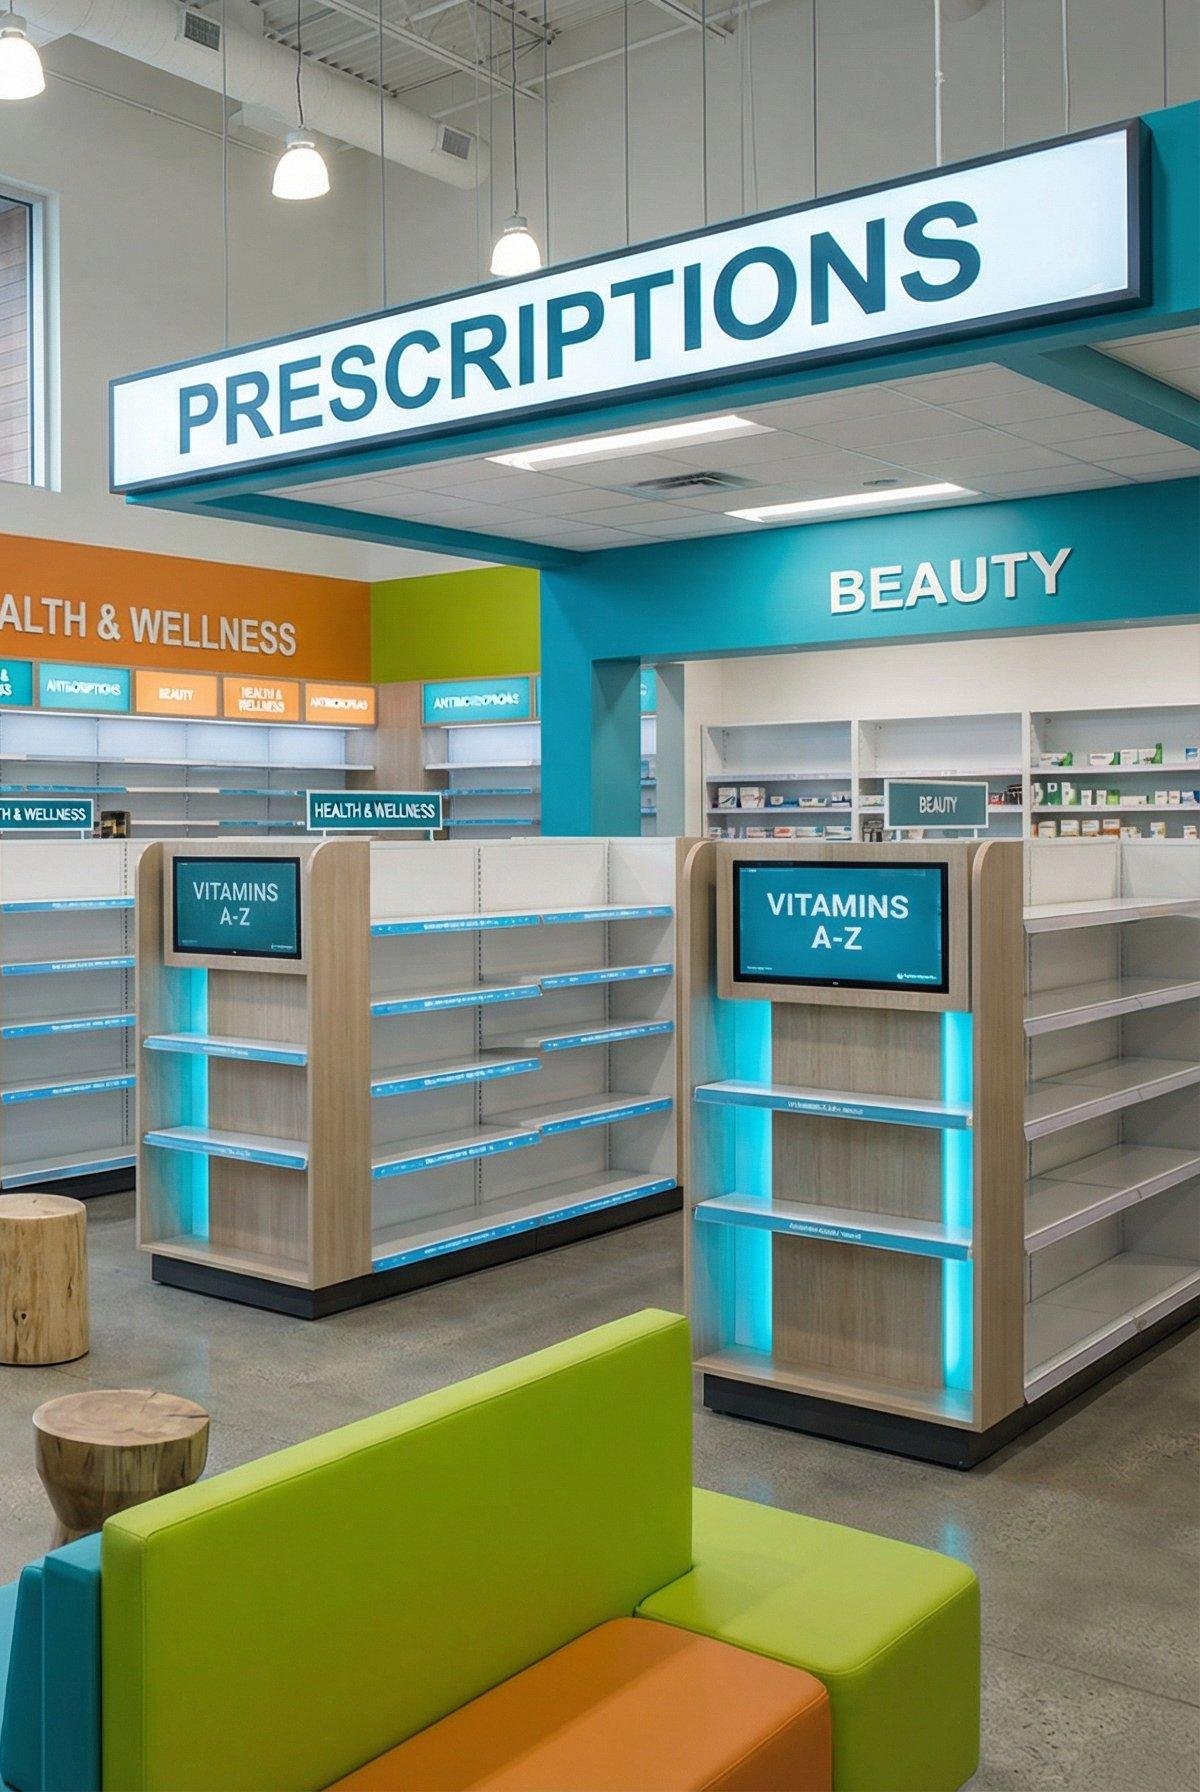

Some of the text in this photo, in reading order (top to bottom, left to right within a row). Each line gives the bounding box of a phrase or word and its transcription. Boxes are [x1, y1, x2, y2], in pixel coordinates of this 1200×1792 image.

[179, 199, 982, 455] PRESCRIPTIONS
[830, 547, 1072, 615] BEAUTY
[97, 603, 121, 641] &
[130, 606, 297, 657] WELLNESS
[0, 668, 9, 682] &
[13, 807, 22, 821] &
[23, 807, 87, 822] WELLNESS
[314, 801, 436, 820] HEALTH & WELLNESS
[919, 796, 958, 814] BEAUTY
[192, 881, 279, 902] VITAMINS
[219, 905, 251, 926] A-Z
[766, 892, 909, 920] VITAMINS
[811, 925, 863, 951] A-Z
